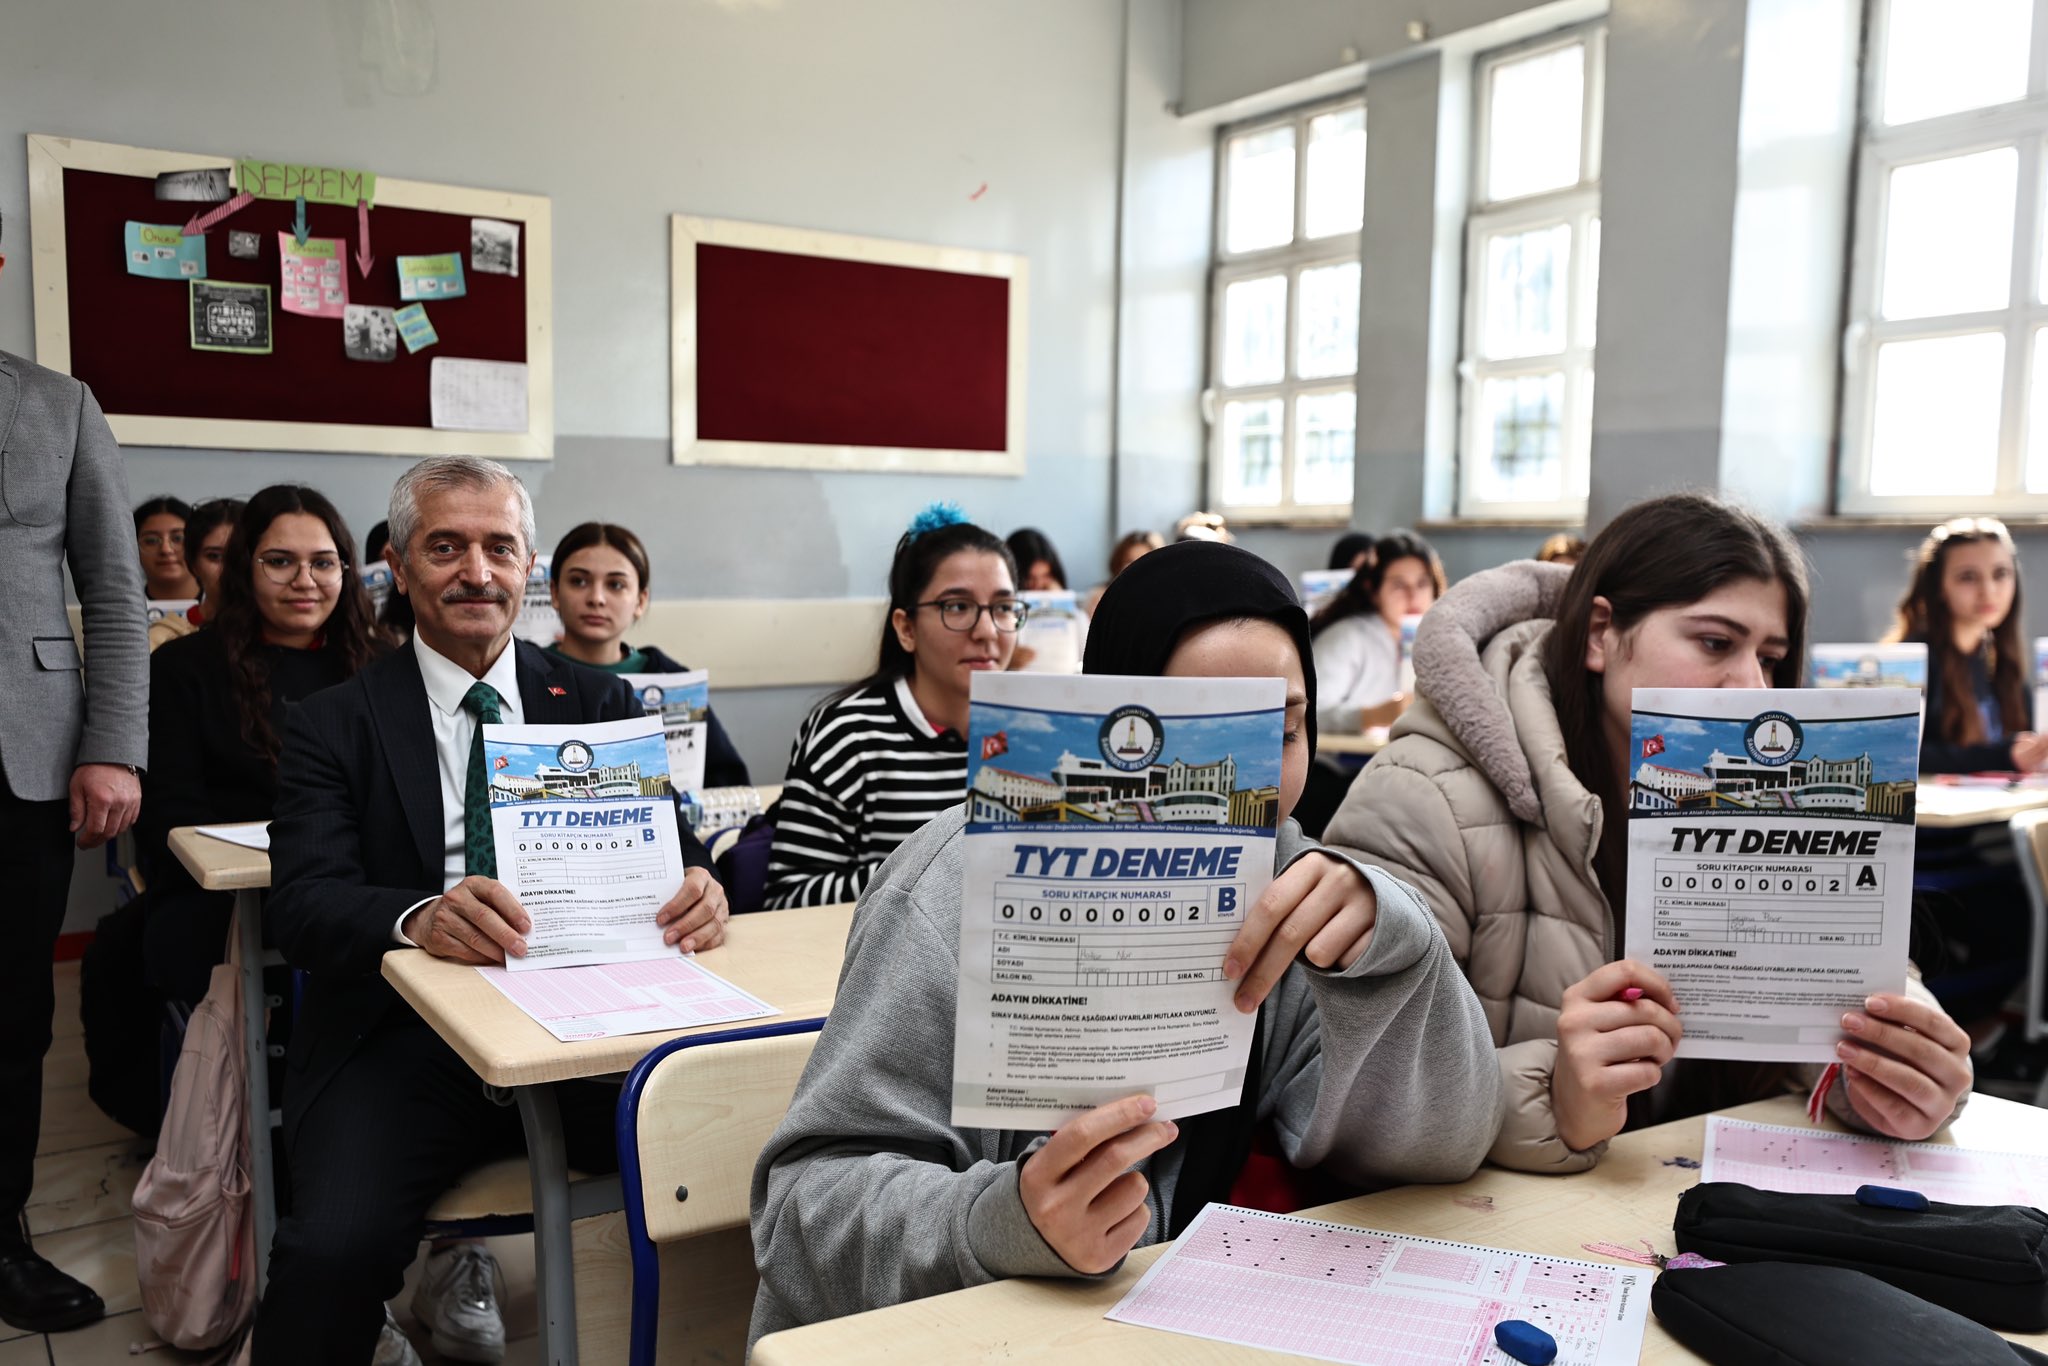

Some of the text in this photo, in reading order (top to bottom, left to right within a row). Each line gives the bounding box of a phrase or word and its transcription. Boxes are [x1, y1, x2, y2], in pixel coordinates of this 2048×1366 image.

[241, 163, 363, 200] DEPREM
[521, 807, 653, 827] TYT DENEME
[642, 828, 656, 842] B
[1671, 827, 1882, 856] TYT DENEME
[519, 839, 633, 851] 0 0 0 0 0 0 0 2
[1013, 844, 1243, 878] TYT DENEME
[1696, 863, 1812, 873] SORU KİTAPÇIK NUMARASI
[1855, 865, 1878, 887] A
[1662, 876, 1840, 892] 0 0 0 0 0 0 0 2
[544, 888, 576, 896] DİKKATİNE!
[1042, 889, 1171, 901] SORU KİTAPÇIK NUMARASI
[1217, 887, 1237, 912] B
[1002, 904, 1199, 922] 0 0 0 0 0 0 0 2
[1038, 935, 1076, 943] NUMARASI
[1653, 947, 1737, 958] ADAYIN DİKKATİNE!
[996, 959, 1024, 967] SOYADI
[991, 993, 1088, 1006] ADAYIN DİKKATİNE!
[1013, 1012, 1060, 1021] BAŞLAMADAN
[1061, 1013, 1080, 1021] ÖNCE
[1081, 1013, 1118, 1022] AŞAĞIDAKİ
[1119, 1013, 1153, 1021] UYARILARI
[1154, 1011, 1183, 1019] MUTLAKA
[1184, 1008, 1217, 1017] OKUYUNUZ.
